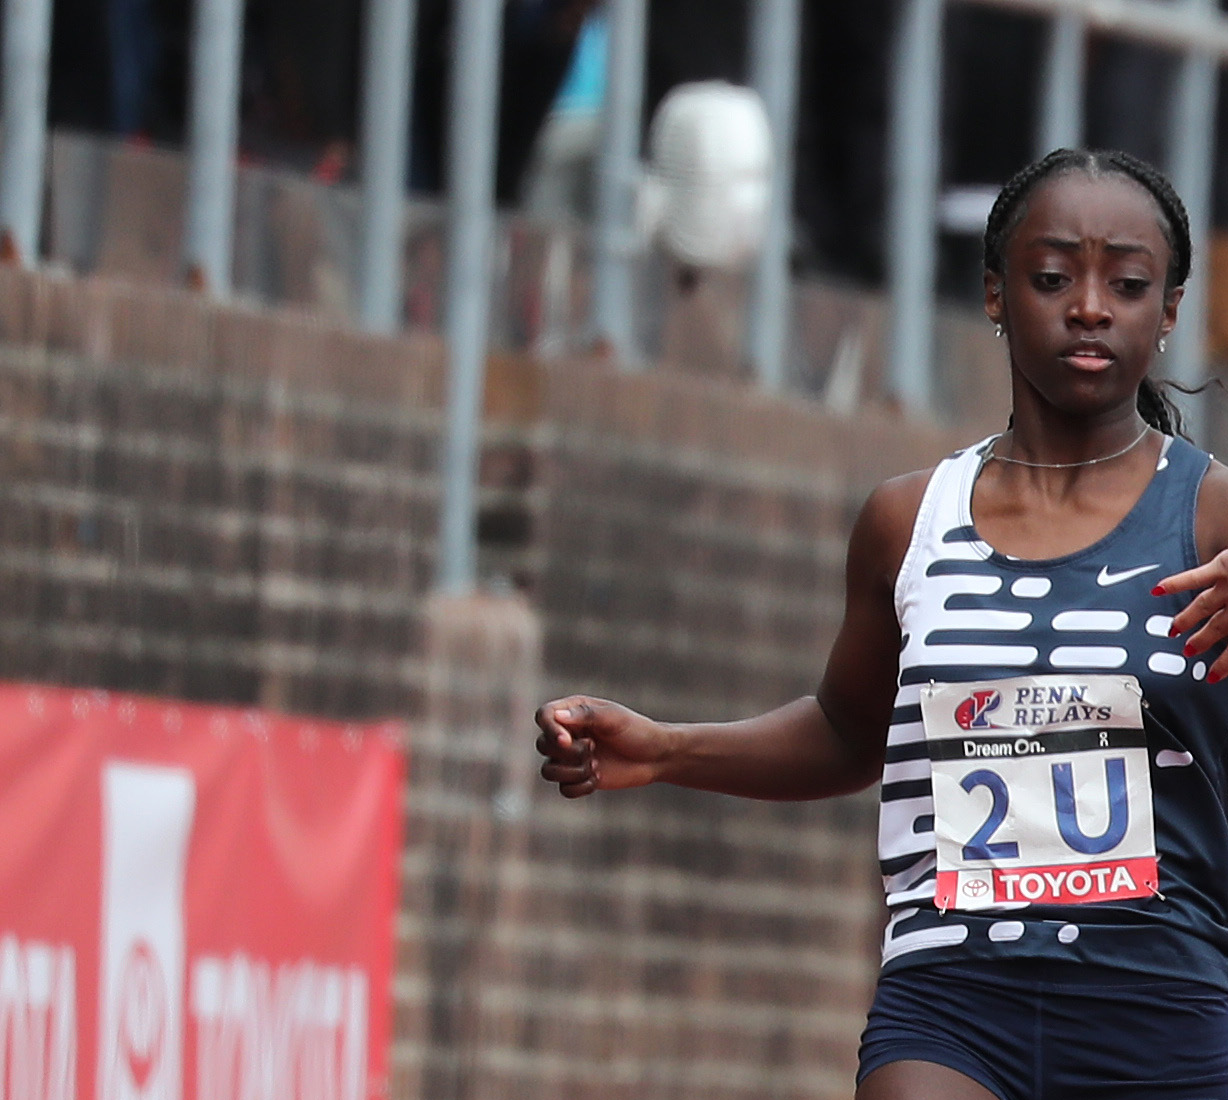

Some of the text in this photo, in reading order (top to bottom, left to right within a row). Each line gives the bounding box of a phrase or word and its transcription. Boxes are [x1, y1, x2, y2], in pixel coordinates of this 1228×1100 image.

[1015, 685, 1088, 705] PENN
[1013, 705, 1111, 726] RELAYS
[963, 738, 1045, 757] Dream On.
[960, 758, 1129, 861] 2 U
[999, 866, 1137, 900] TOYOTA
